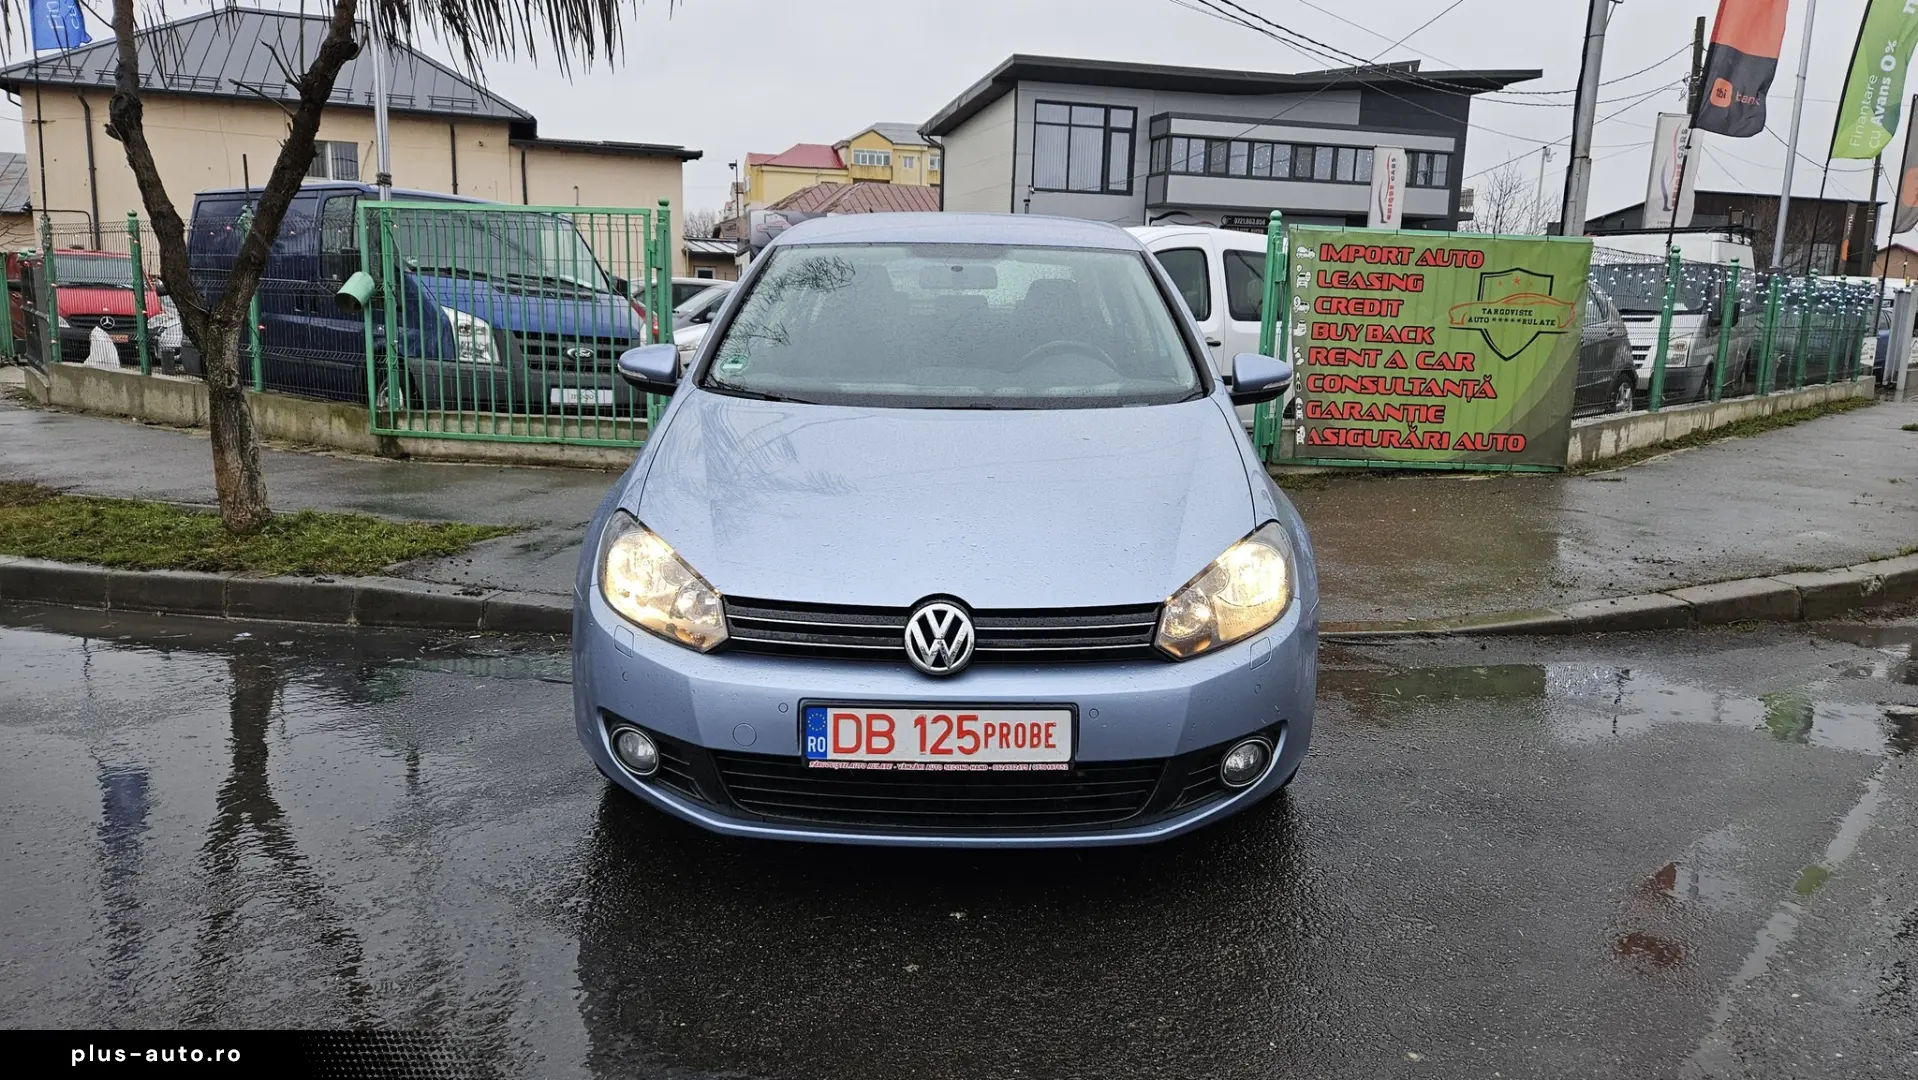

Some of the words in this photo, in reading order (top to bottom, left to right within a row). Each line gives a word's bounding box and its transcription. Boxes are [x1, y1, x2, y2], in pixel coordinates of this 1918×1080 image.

[1871, 76, 1891, 127] Avans
[1677, 128, 1688, 159] CARS
[1319, 243, 1415, 265] IMPORT
[1415, 248, 1485, 269] AUTO
[1316, 270, 1424, 292] LEASING
[1314, 296, 1404, 317] CREDIT
[1481, 307, 1533, 317] TARGOVISTE
[1311, 322, 1364, 341] BUY
[1365, 324, 1435, 344] BACK
[1308, 346, 1382, 368] RENT
[1384, 349, 1408, 369] A
[1415, 351, 1476, 372] CAR
[1306, 373, 1498, 402] CONSULTANȚĂ
[1306, 400, 1446, 426] GARANȚIE
[1308, 424, 1450, 450] ASIGURĂRI
[1452, 432, 1527, 452] AUTO
[807, 736, 826, 753] RO
[832, 713, 896, 755] DB
[913, 714, 982, 755] 125
[983, 721, 1057, 749] PROBE
